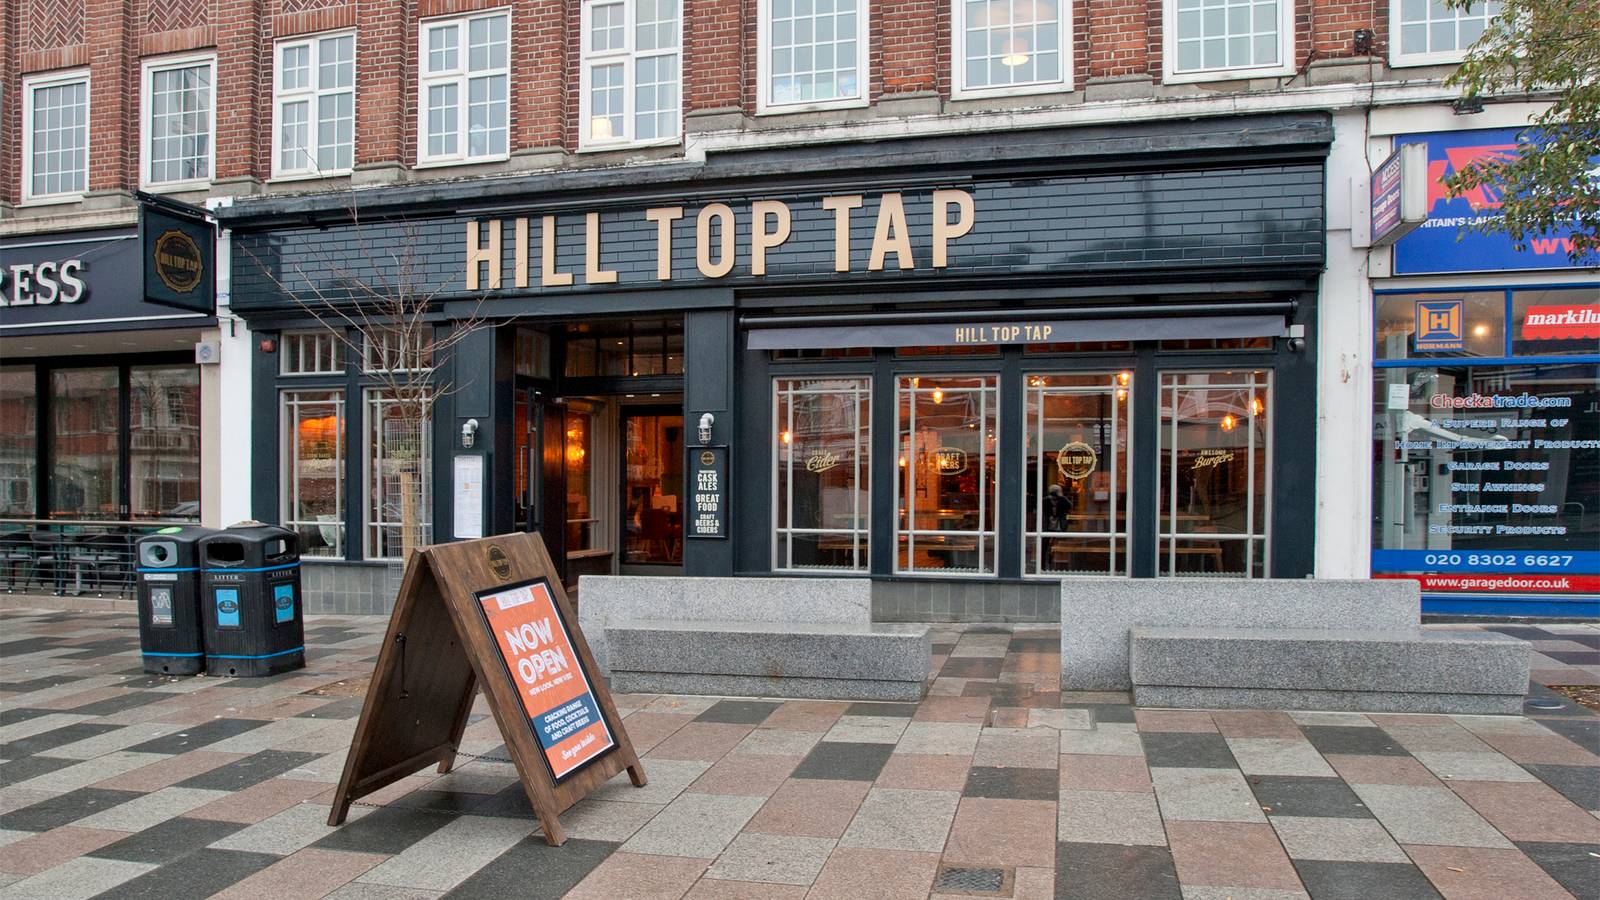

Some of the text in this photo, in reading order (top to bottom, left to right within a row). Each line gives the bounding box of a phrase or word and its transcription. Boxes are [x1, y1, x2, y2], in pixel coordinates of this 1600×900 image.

[466, 189, 975, 290] HILL TOP TAP
[955, 325, 1052, 343] HILL TOP TAP
[1431, 392, 1572, 408] Checkatrade.com
[1431, 419, 1440, 428] A
[805, 452, 840, 472] Cider
[1191, 453, 1234, 469] Burgers
[697, 473, 718, 482] CASK
[698, 482, 718, 491] ALES
[695, 493, 720, 503] GREAT
[697, 503, 718, 511] FOOD
[695, 519, 720, 527] BEERS &
[696, 526, 718, 534] CIDERS
[1425, 554, 1573, 567] 020 8302 6627
[1426, 577, 1570, 590] www.garagedoor.co.uk
[504, 617, 554, 656] NOW
[518, 644, 568, 684] OPEN
[544, 700, 582, 723] CRACKING RANGE
[544, 725, 552, 734] OF
[565, 706, 590, 723] COCKTAILS
[551, 716, 590, 741] AND CRAFT BEERS
